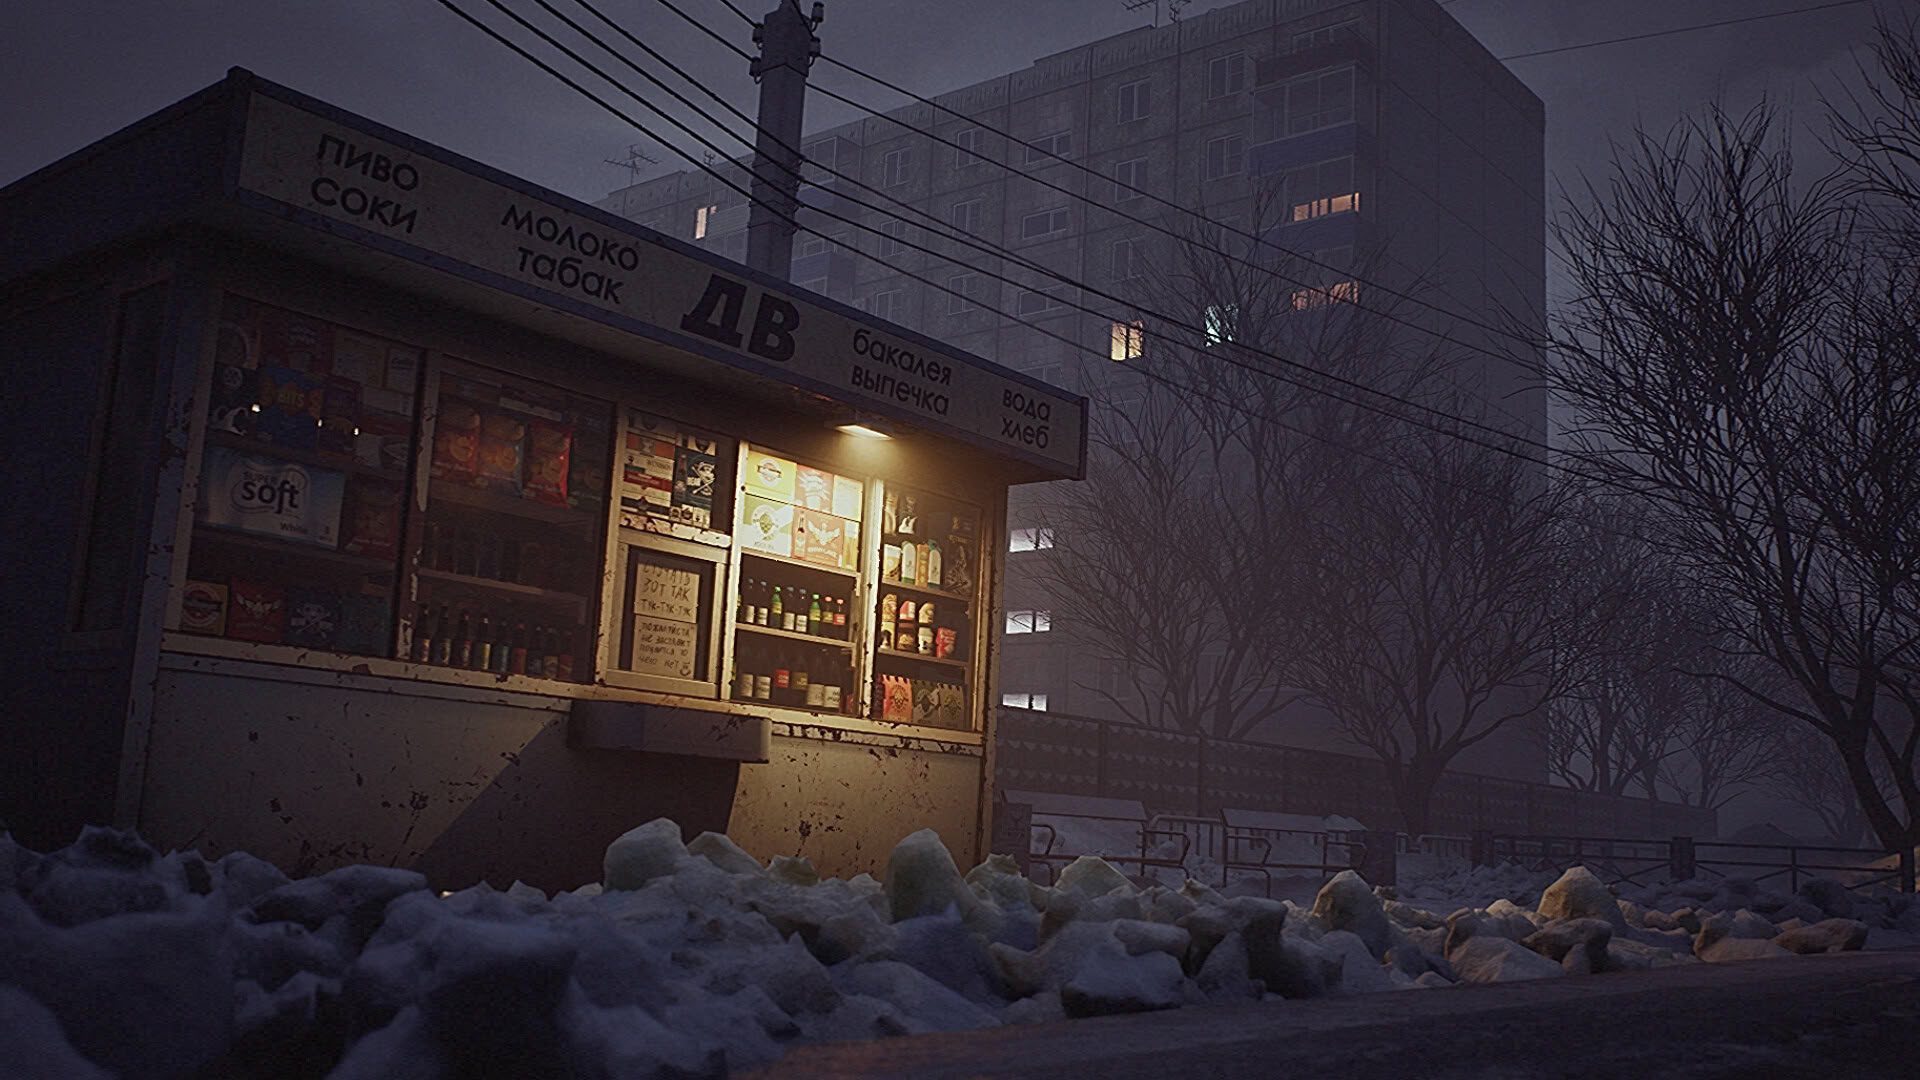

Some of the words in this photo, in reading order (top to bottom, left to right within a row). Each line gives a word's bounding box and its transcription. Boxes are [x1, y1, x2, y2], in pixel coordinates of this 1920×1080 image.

[518, 247, 624, 304] табак
[680, 273, 800, 362] ДВ
[853, 328, 952, 385] бакалея
[851, 365, 949, 417] выпечка
[1002, 389, 1050, 422] вода
[1001, 416, 1049, 449] хлеб
[241, 480, 299, 515] soft
